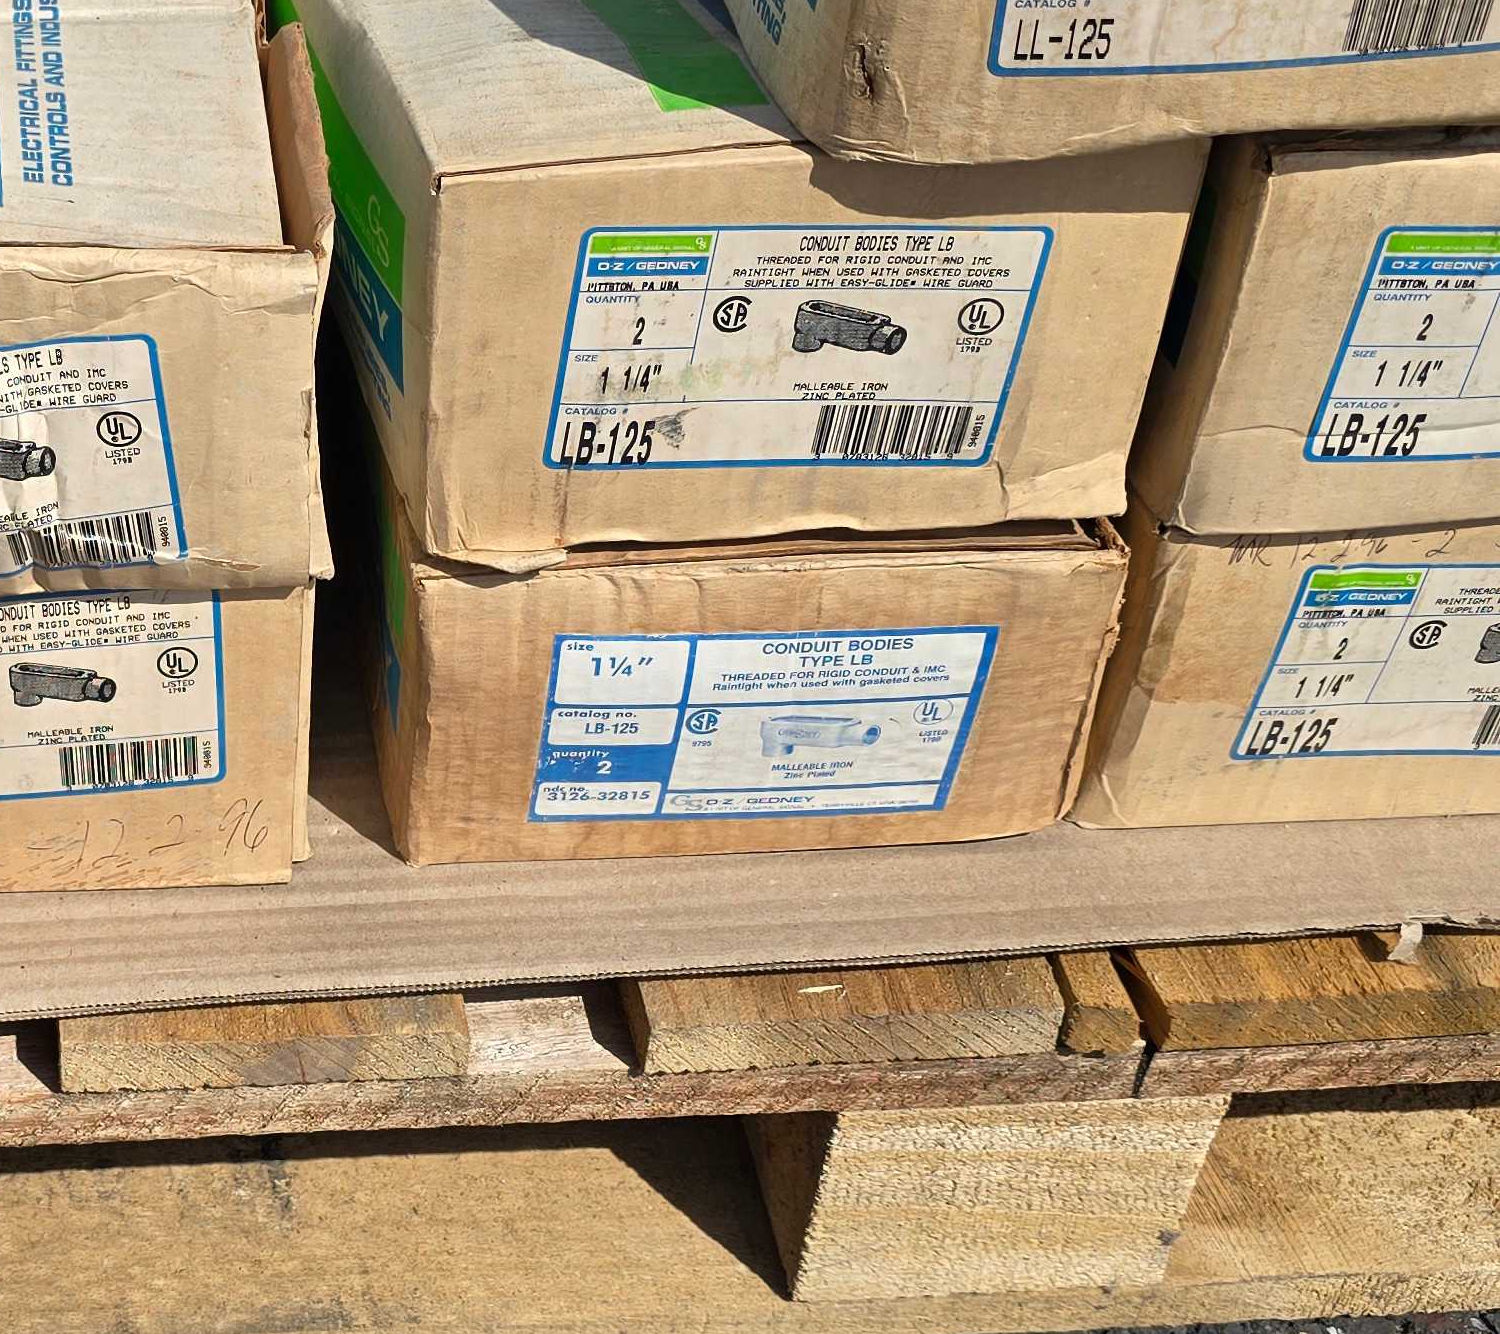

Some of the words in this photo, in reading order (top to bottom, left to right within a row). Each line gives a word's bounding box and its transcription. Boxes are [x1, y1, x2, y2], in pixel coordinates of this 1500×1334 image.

[1015, 0, 1077, 9] CATALOG
[1013, 18, 1114, 61] LL-125
[42, 52, 64, 86] AND
[15, 80, 44, 184] ELECTRICAL
[43, 92, 73, 186] CONTROLS
[855, 237, 899, 251] BODIES
[906, 237, 934, 251] TYPE
[938, 237, 954, 251] LB
[757, 256, 809, 265] THREADED
[846, 256, 880, 265] RIGID
[906, 268, 962, 277] GASKETED
[968, 269, 1010, 277] COVERS
[923, 279, 952, 287] WIRE
[958, 279, 993, 288] GUARD
[586, 295, 641, 305] QUANTITY
[956, 338, 992, 346] LISTED
[14, 353, 44, 374] TYPE
[794, 382, 856, 392] MALLEABLE
[861, 382, 888, 391] IRON
[1321, 414, 1427, 456] LB-125
[560, 421, 656, 465] LB-125
[42, 602, 80, 619] BODIES
[85, 599, 113, 615] TYPE
[567, 642, 594, 651] size
[762, 640, 840, 654] CONDUIT
[847, 638, 914, 651] BODIES
[799, 656, 842, 667] TYPE
[850, 654, 873, 665] LB
[721, 672, 785, 681] THREADED
[790, 671, 815, 679] FOR
[819, 669, 851, 678] RIGID
[855, 667, 908, 677] CONDUIT
[801, 680, 828, 688] used
[833, 678, 856, 687] with
[860, 676, 908, 688] gasketed
[914, 674, 949, 682] covers
[557, 710, 611, 719] catalog
[616, 711, 637, 719] no.
[584, 722, 638, 735] LB-125
[1245, 718, 1338, 755] LB-125
[771, 762, 827, 771] MALLEABLE
